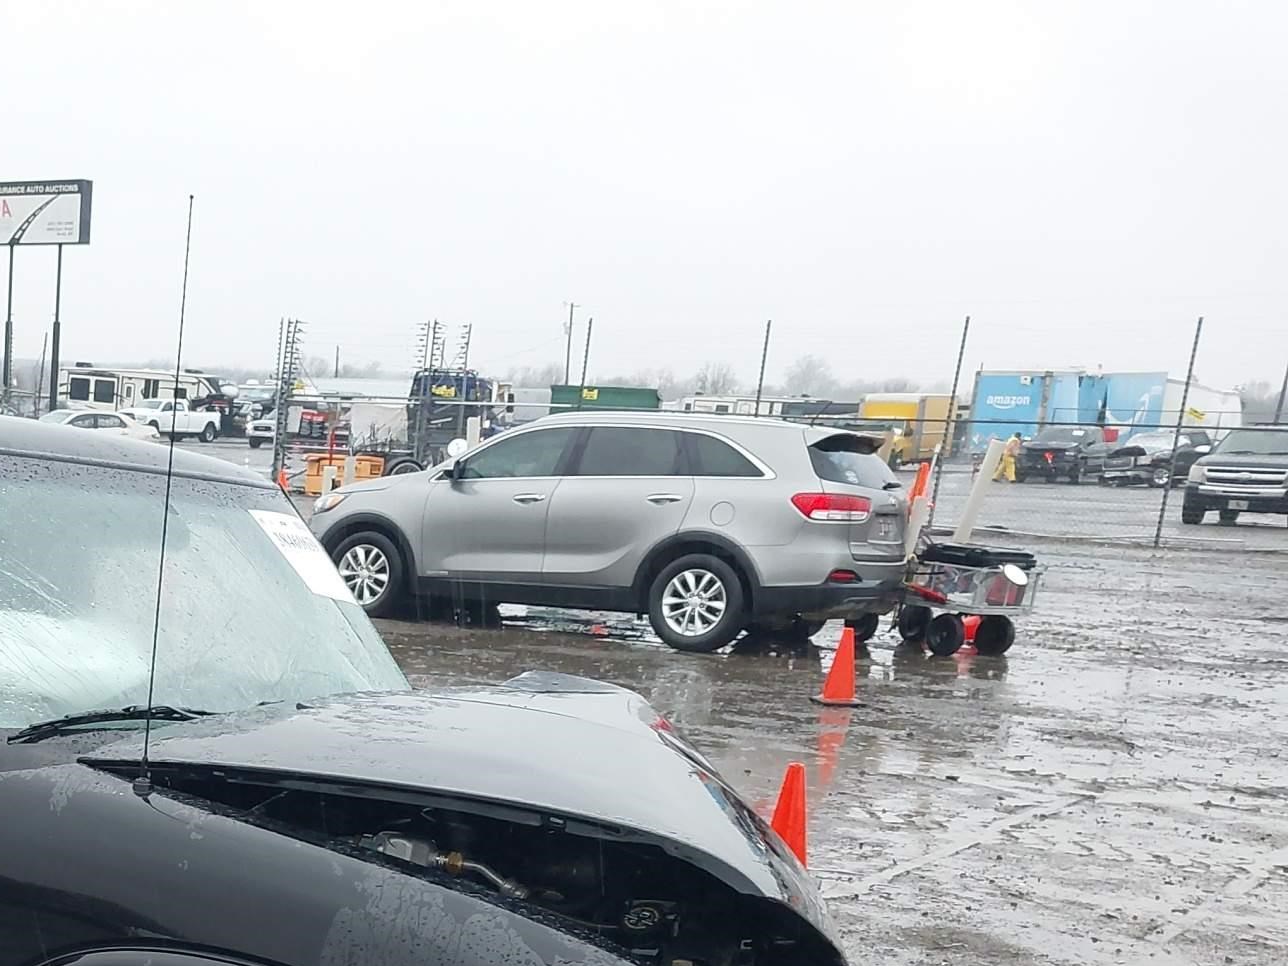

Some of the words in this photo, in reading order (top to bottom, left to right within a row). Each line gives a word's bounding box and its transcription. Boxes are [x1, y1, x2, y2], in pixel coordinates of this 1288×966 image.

[26, 185, 44, 193] AUTO
[45, 184, 78, 193] AUCTIONS
[987, 395, 1030, 406] amazon
